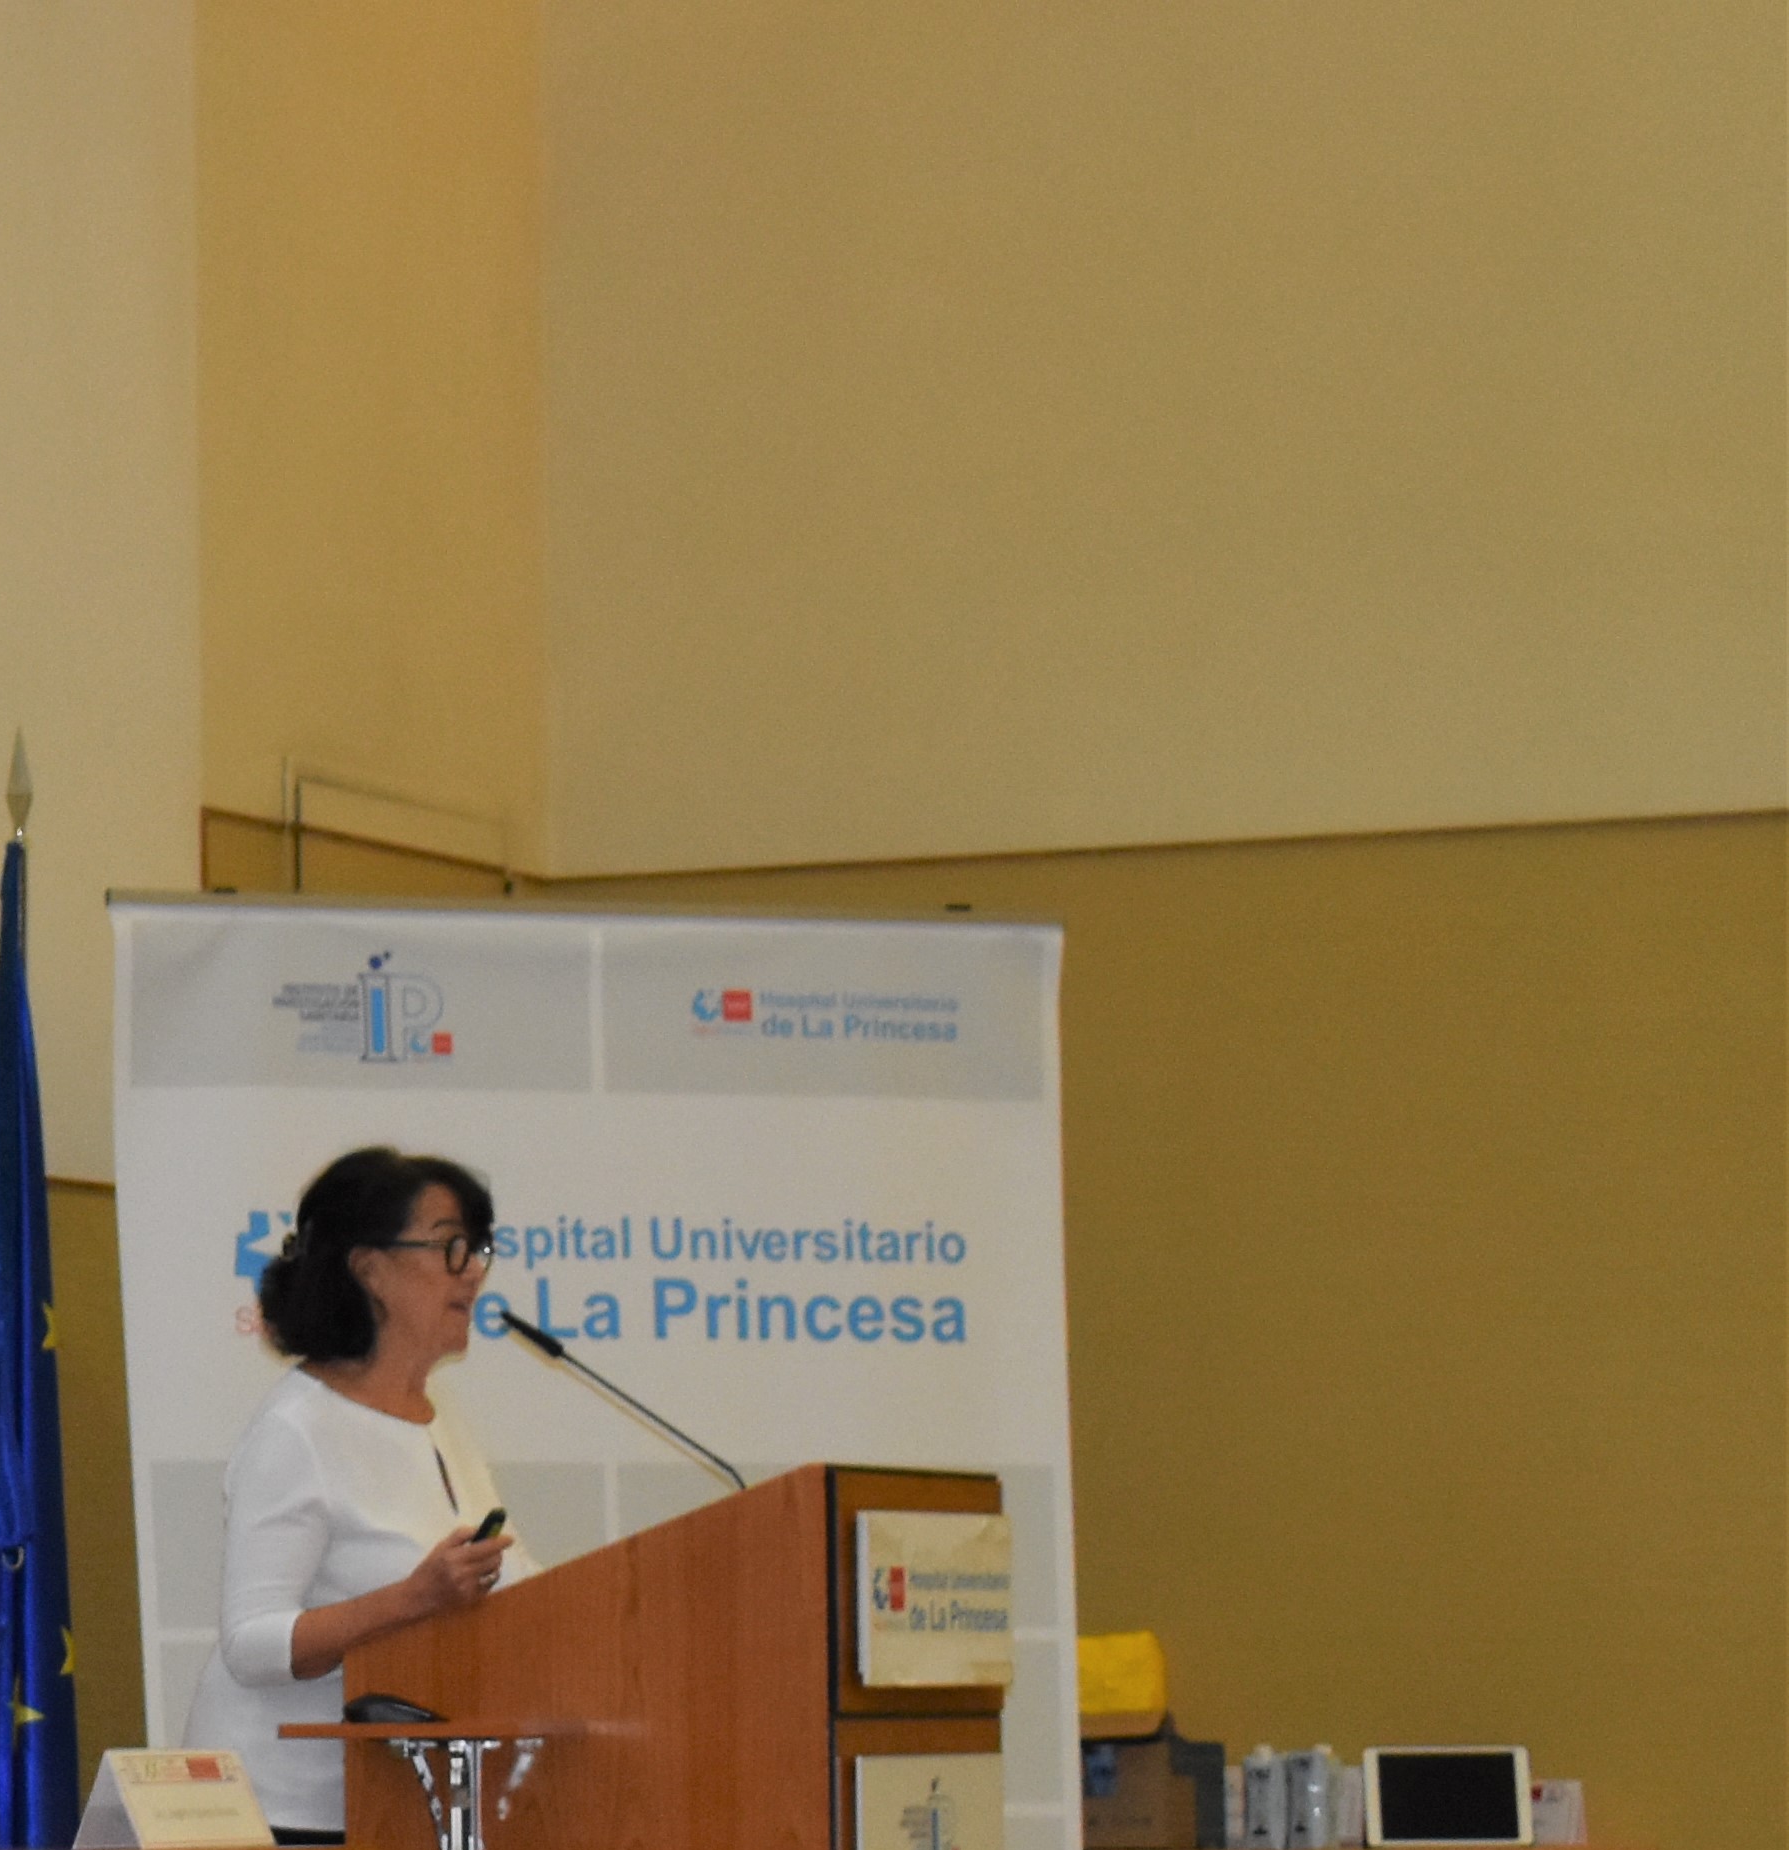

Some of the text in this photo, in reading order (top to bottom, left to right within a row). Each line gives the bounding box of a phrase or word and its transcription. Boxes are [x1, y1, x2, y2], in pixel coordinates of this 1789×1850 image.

[494, 1214, 966, 1271] spital Universitario
[537, 1278, 621, 1340] La
[653, 1277, 967, 1344] Princesa
